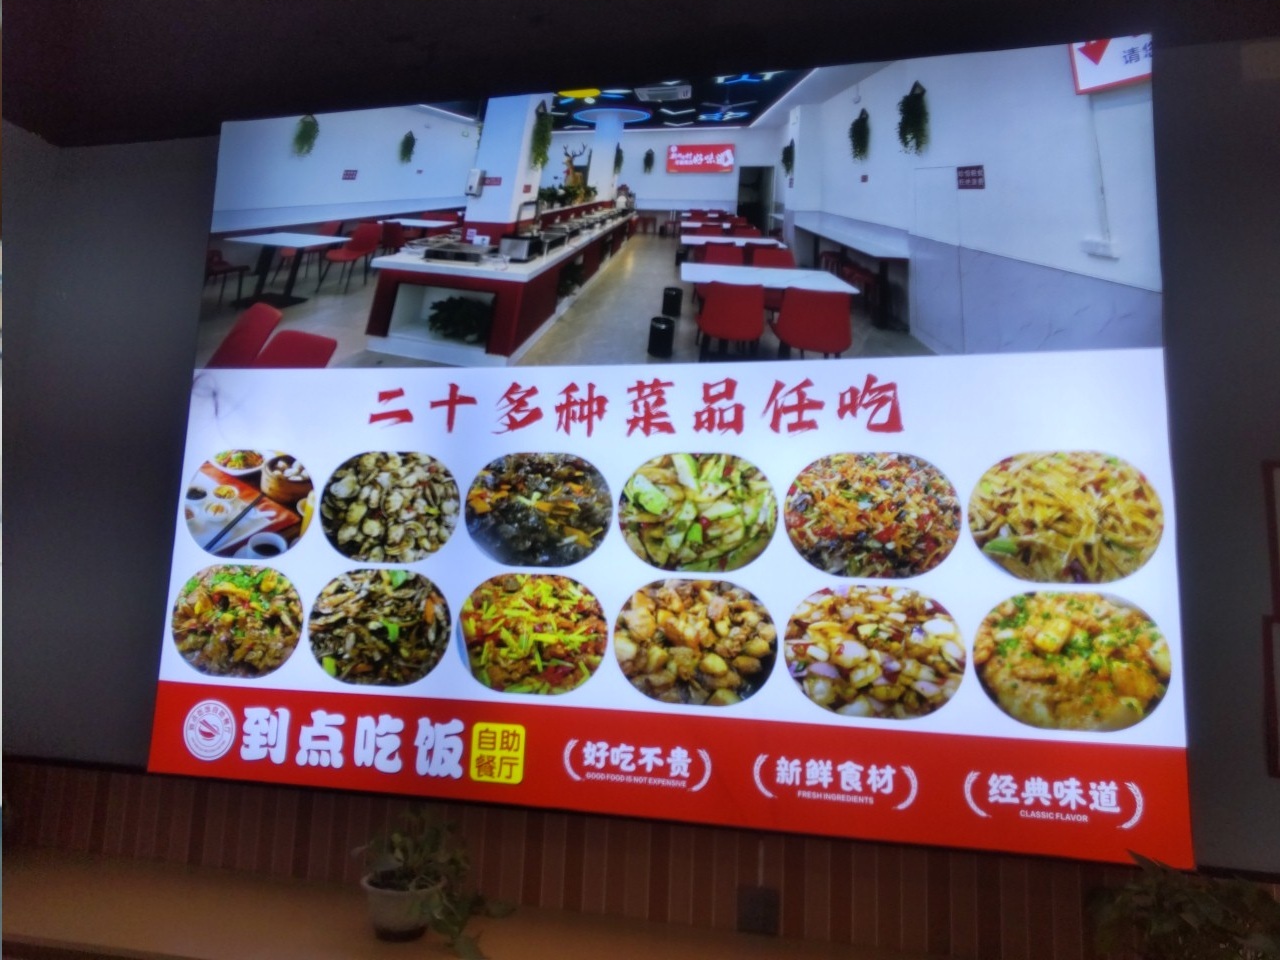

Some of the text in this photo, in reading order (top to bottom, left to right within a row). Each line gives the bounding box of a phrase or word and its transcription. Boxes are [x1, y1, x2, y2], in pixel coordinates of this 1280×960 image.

[368, 374, 905, 437] 二十多种菜品任吃
[240, 706, 470, 780] 到点吃饭
[476, 728, 521, 753] 自助
[474, 754, 520, 782] 餐厅
[583, 740, 692, 778] 好吃不贵
[776, 756, 896, 794] 新鲜食材
[586, 772, 606, 780] GOOD
[606, 774, 625, 782] FOOD
[633, 776, 647, 784] NOT
[648, 778, 687, 788] EXPENSIVE
[987, 772, 1122, 813] 经典味道
[798, 790, 874, 805] FRESH INGREDIENTS
[1019, 810, 1088, 823] CLASSIC FLAVOR
